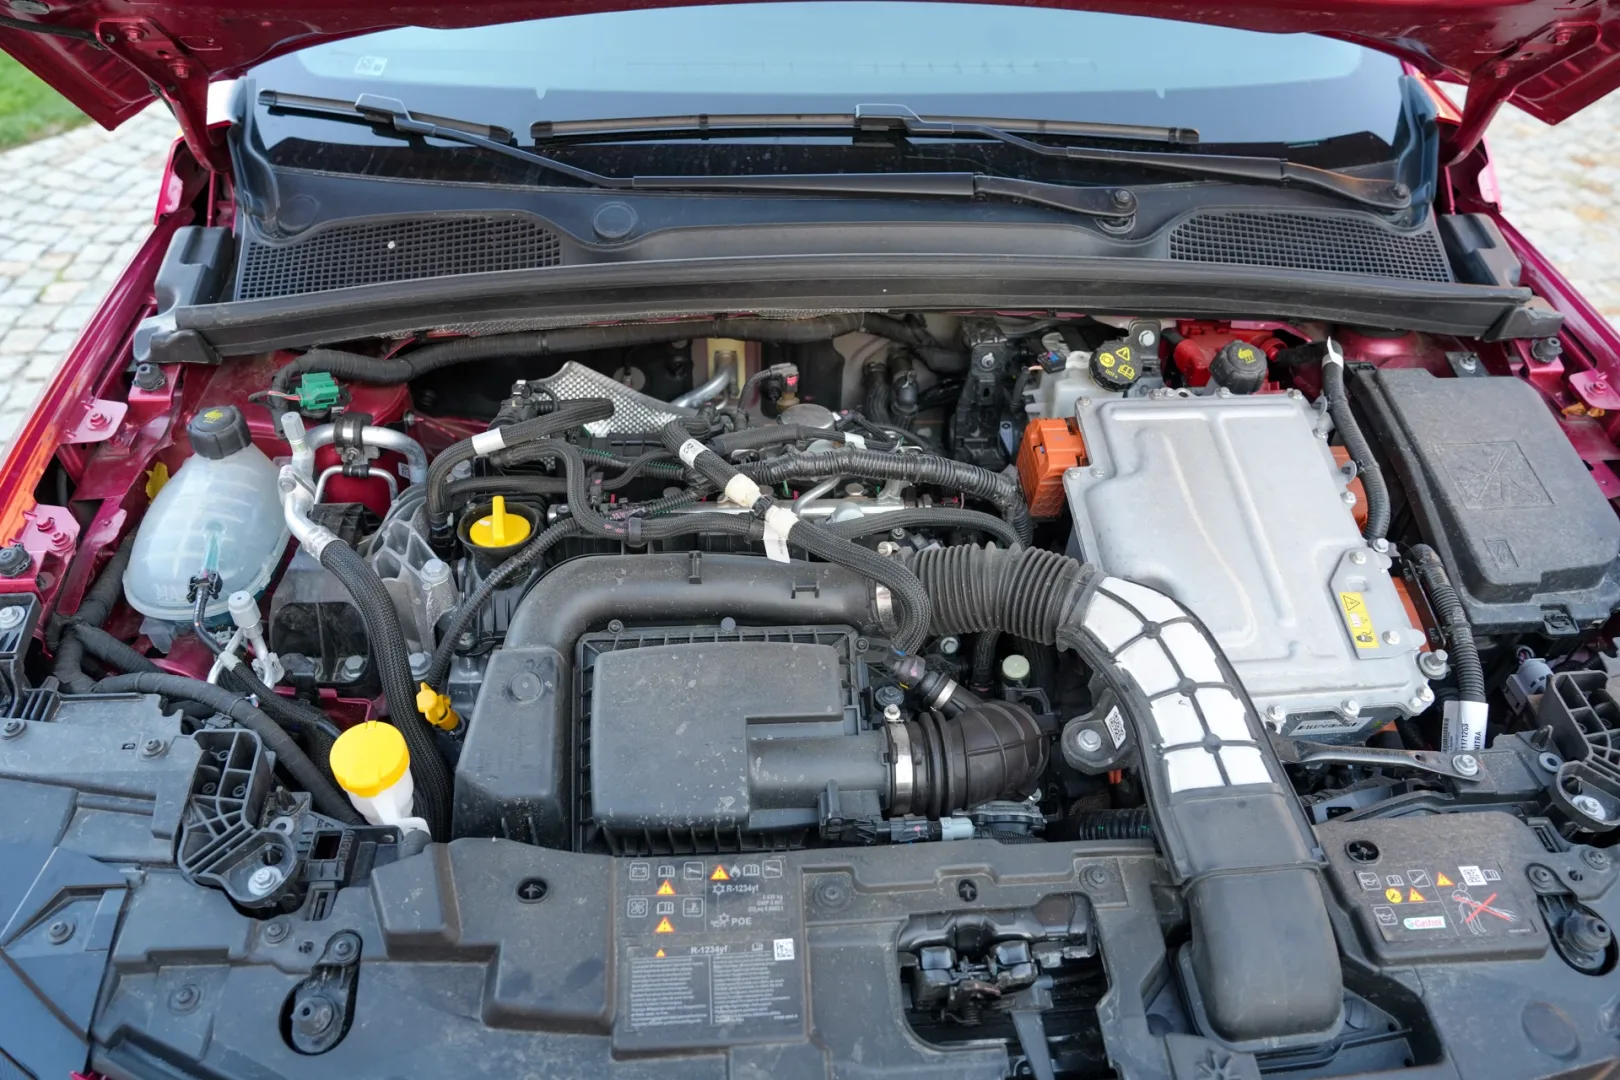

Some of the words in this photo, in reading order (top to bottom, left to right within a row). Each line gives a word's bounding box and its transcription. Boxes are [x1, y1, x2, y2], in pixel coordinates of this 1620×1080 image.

[726, 884, 759, 894] R-1234yf
[731, 917, 752, 926] POE
[1414, 918, 1443, 927] Castrol
[690, 944, 729, 955] R-1234yf
